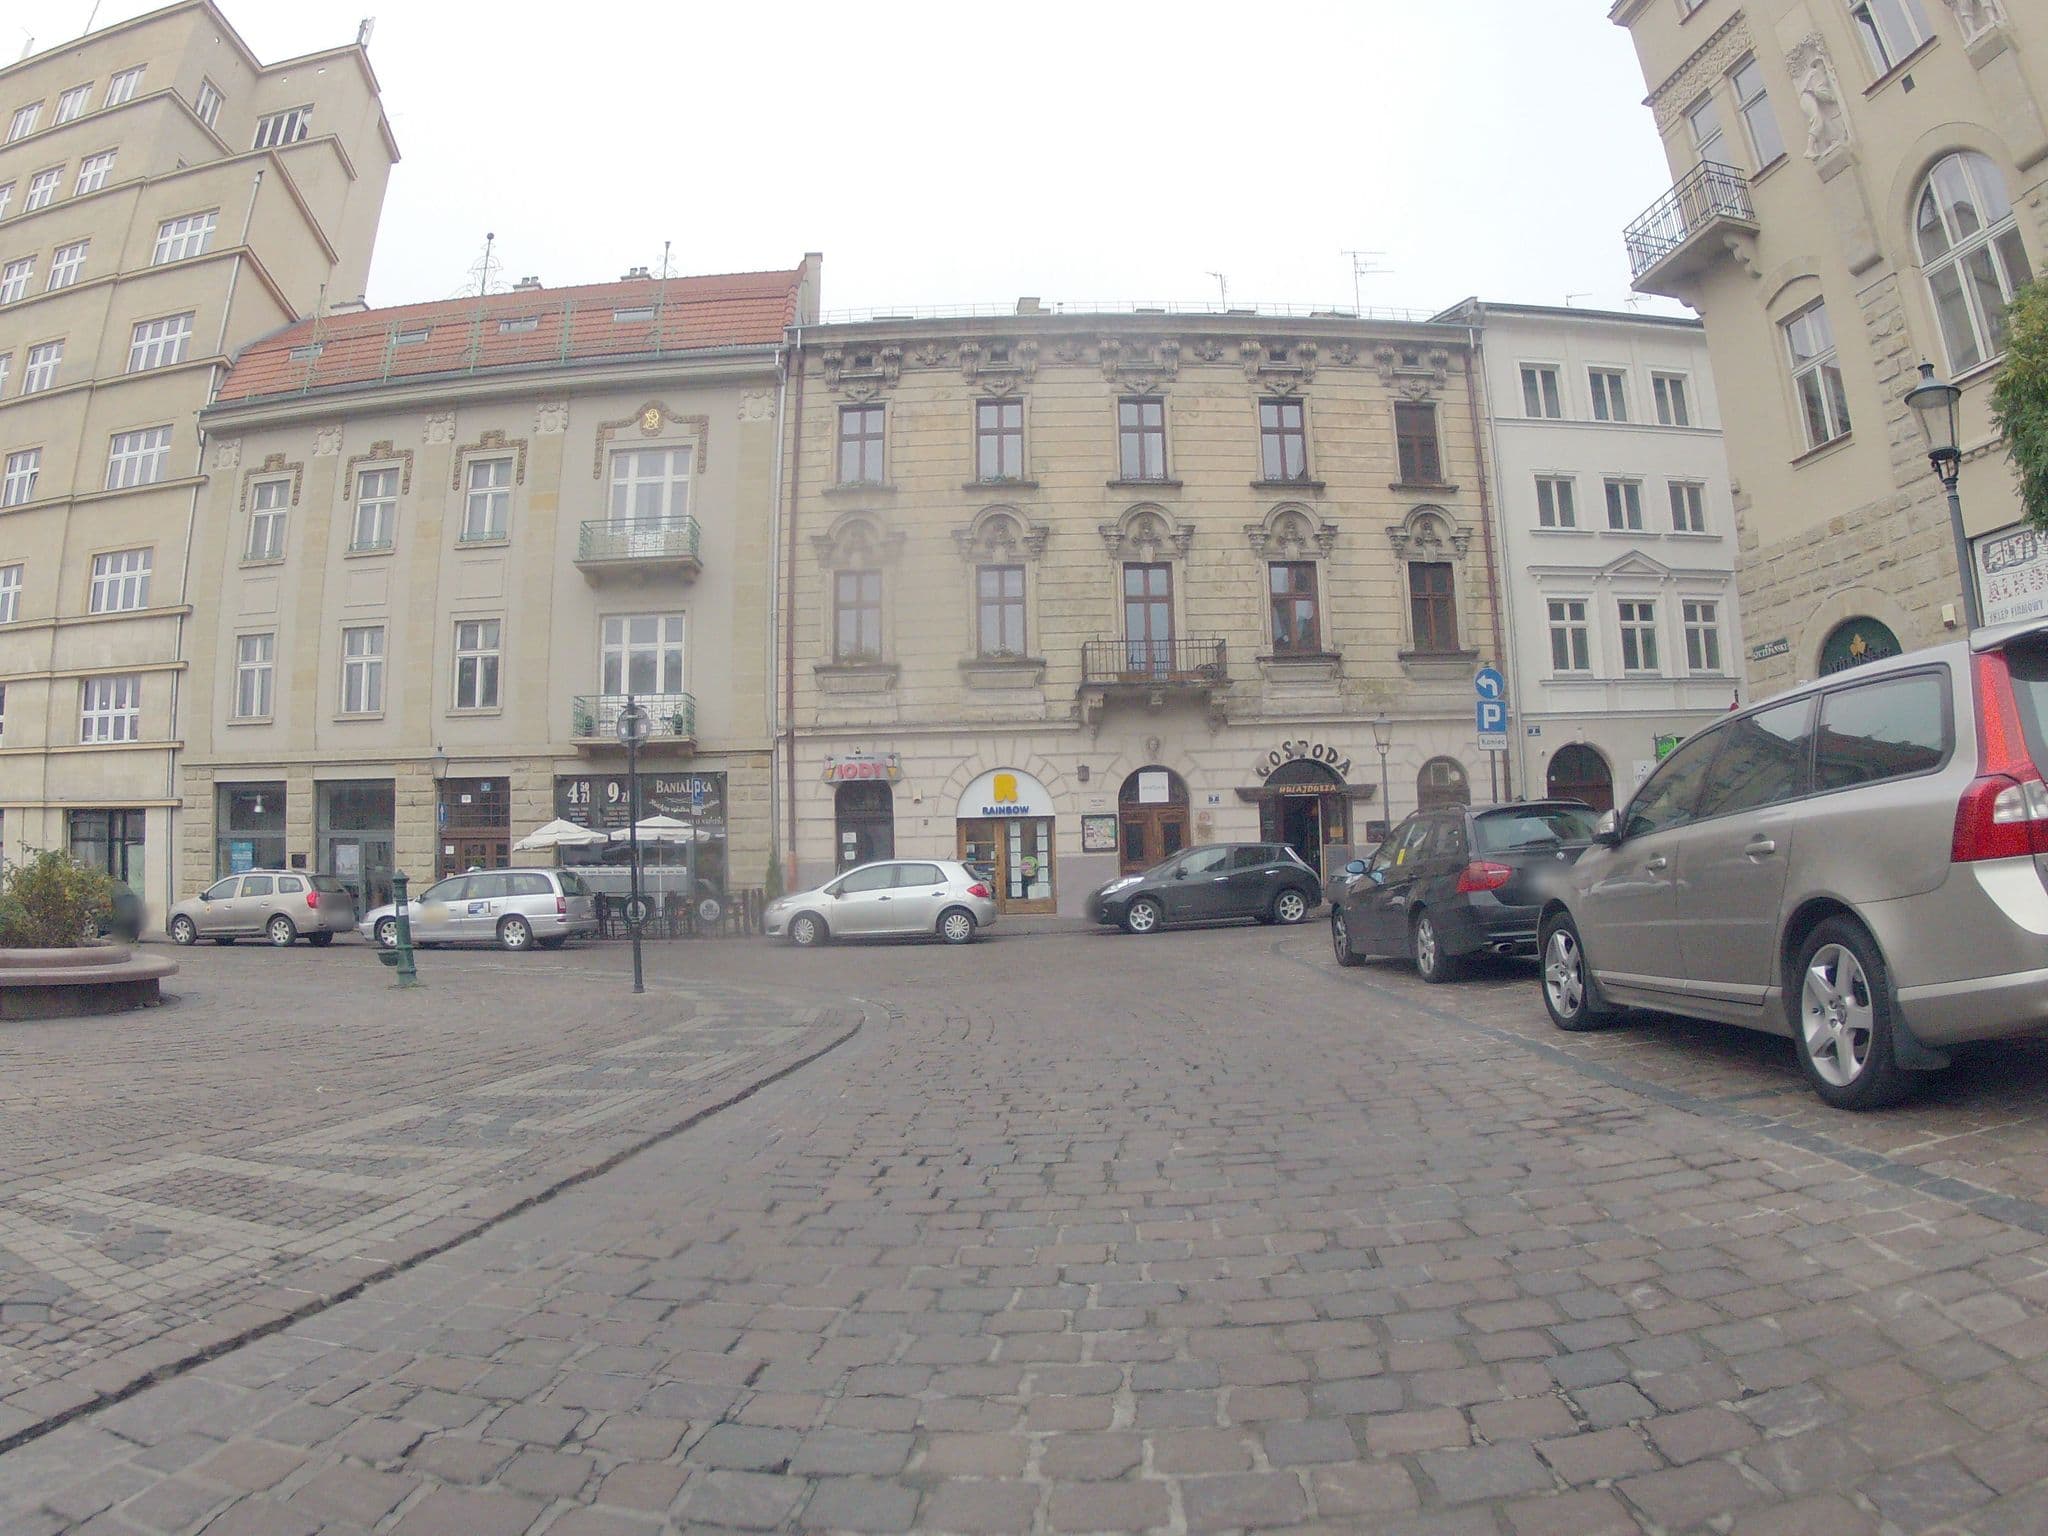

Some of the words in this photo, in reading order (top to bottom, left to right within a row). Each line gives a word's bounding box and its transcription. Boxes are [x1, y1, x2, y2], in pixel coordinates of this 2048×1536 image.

[1483, 704, 1500, 729] P
[567, 782, 579, 804] 4
[607, 782, 619, 803] 9
[982, 805, 1030, 815] RAINBOW
